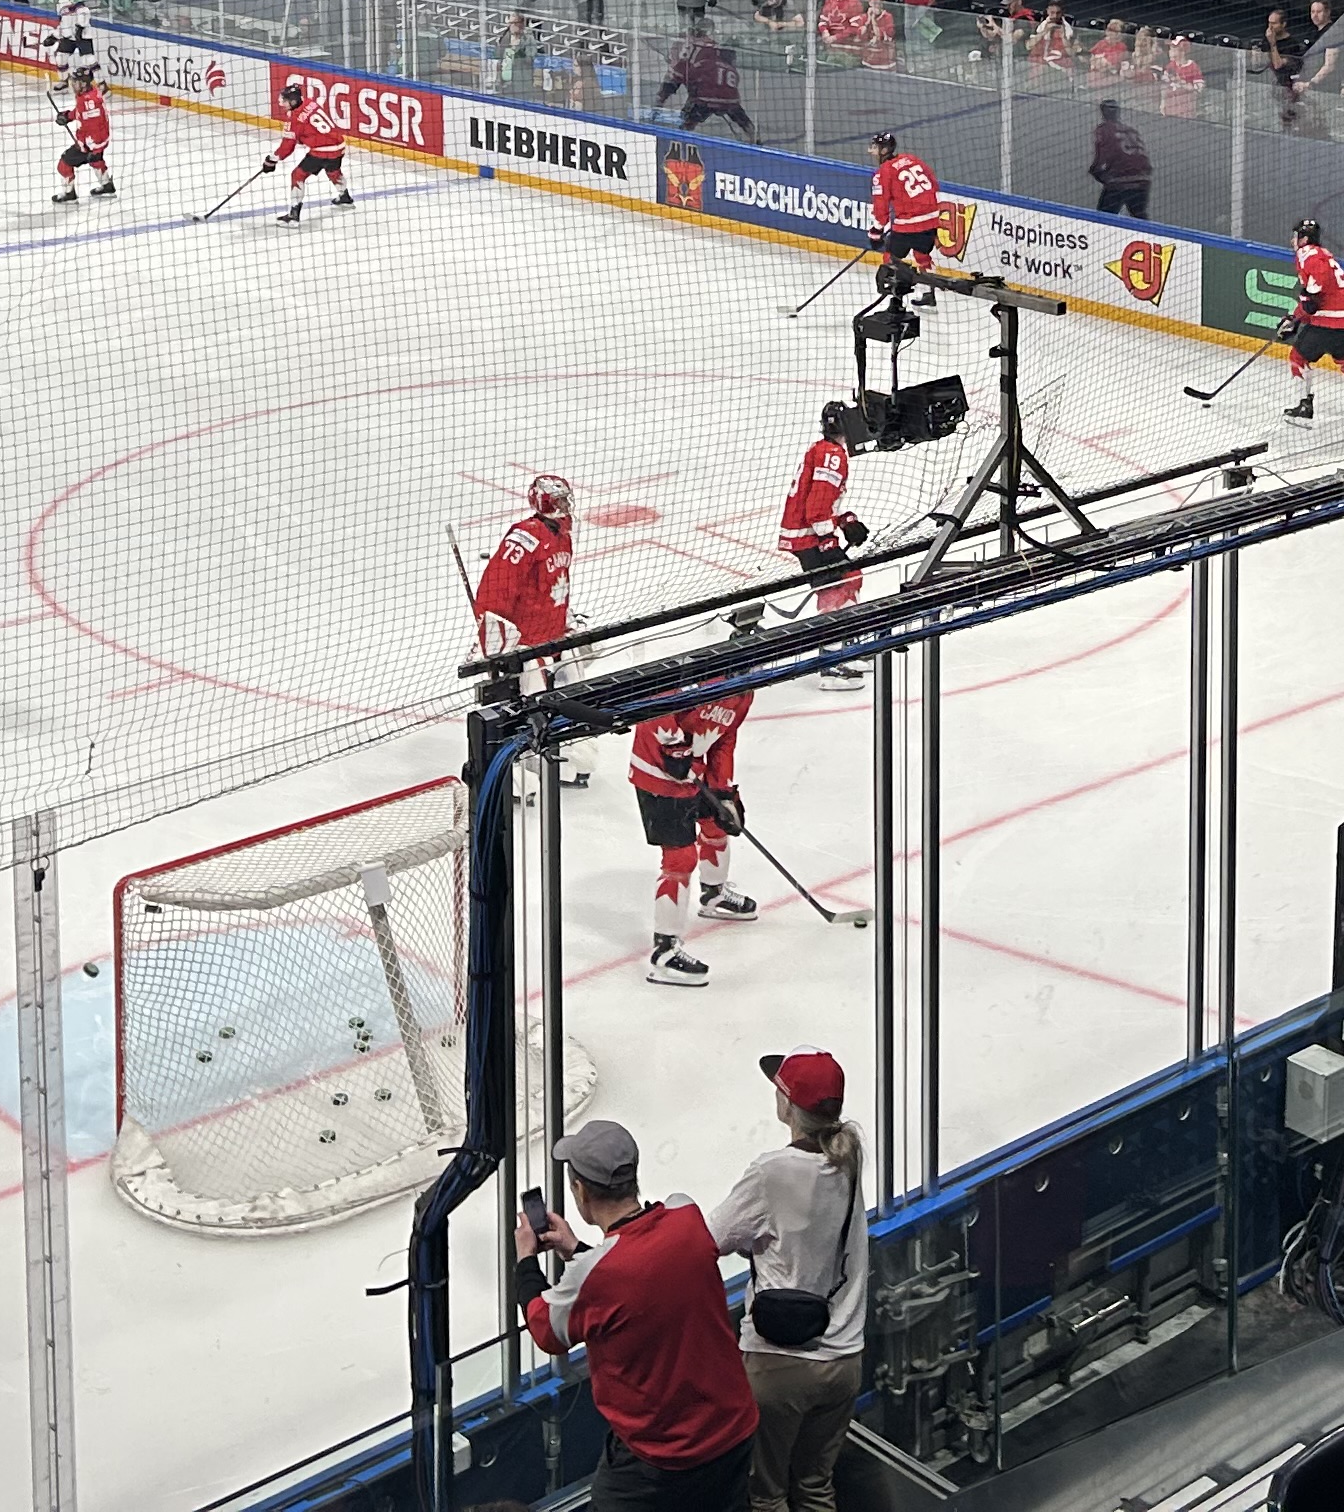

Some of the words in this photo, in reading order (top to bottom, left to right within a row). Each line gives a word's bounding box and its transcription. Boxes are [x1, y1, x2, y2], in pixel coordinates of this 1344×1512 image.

[358, 88, 425, 145] SSR
[470, 117, 628, 181] LIEBHERR
[898, 164, 933, 199] 25
[991, 213, 1089, 250] Happiness
[1000, 250, 1022, 269] at
[823, 452, 842, 471] 19
[502, 540, 525, 565] 73
